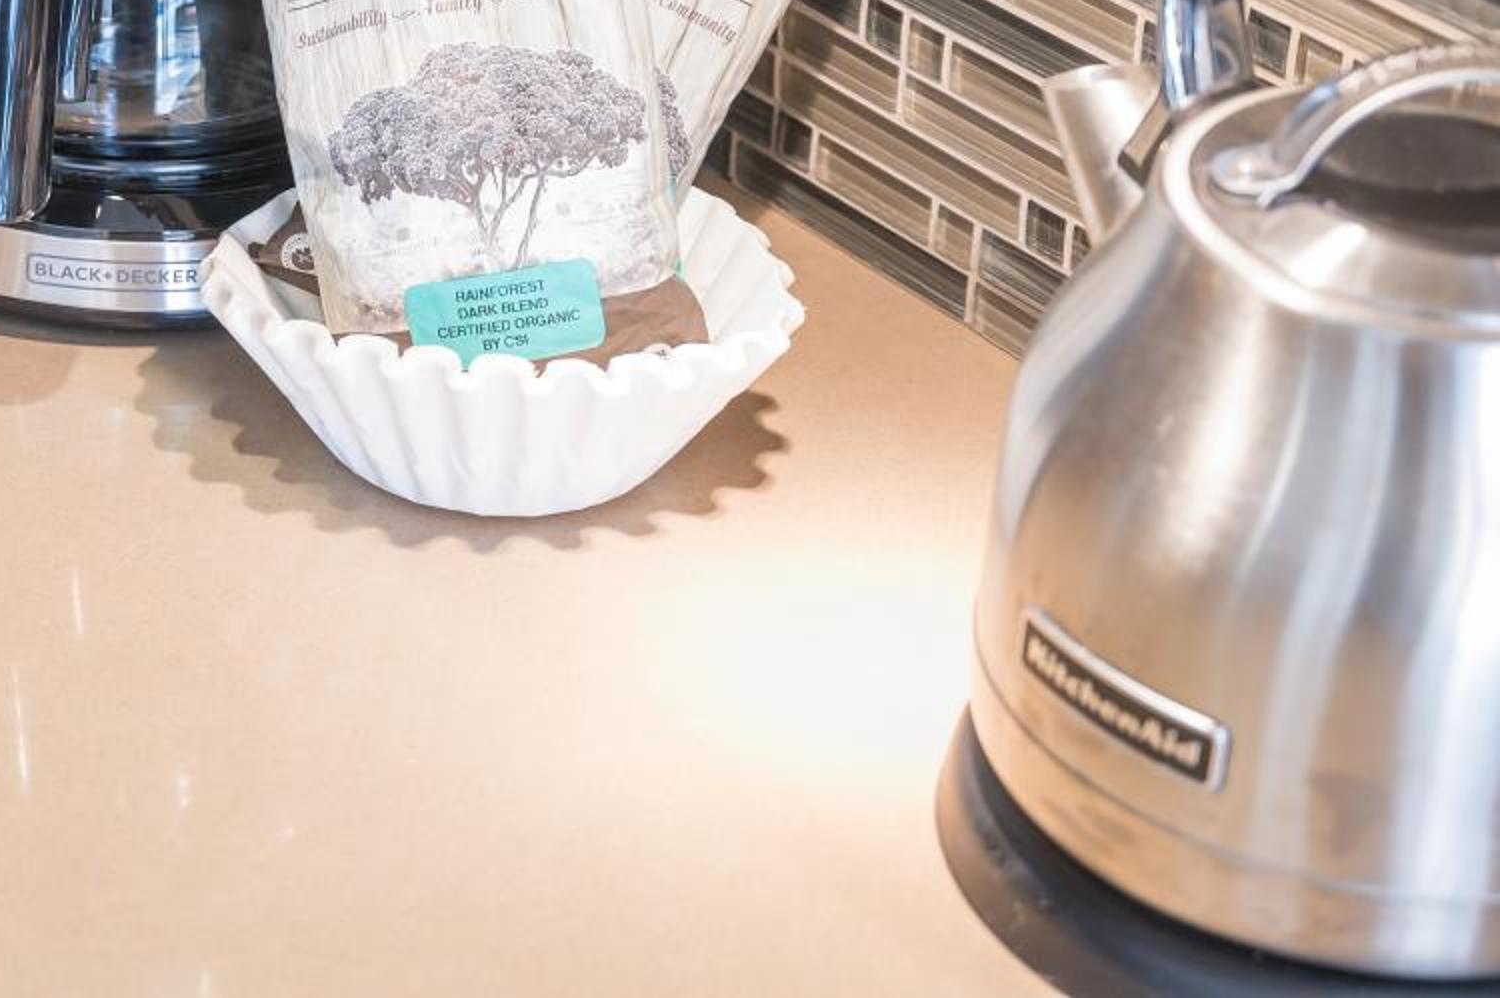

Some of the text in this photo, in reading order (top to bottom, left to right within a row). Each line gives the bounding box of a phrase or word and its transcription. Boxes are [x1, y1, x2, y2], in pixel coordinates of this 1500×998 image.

[296, 8, 389, 49] Sustainability
[35, 262, 198, 284] BLACK+DECKER
[455, 278, 546, 303] RAINFOREST
[457, 297, 550, 321] DARK BLEND
[437, 308, 582, 340] CERTIFIED ORGANIC
[482, 335, 501, 352] BY
[1025, 635, 1203, 766] KitchenAid
